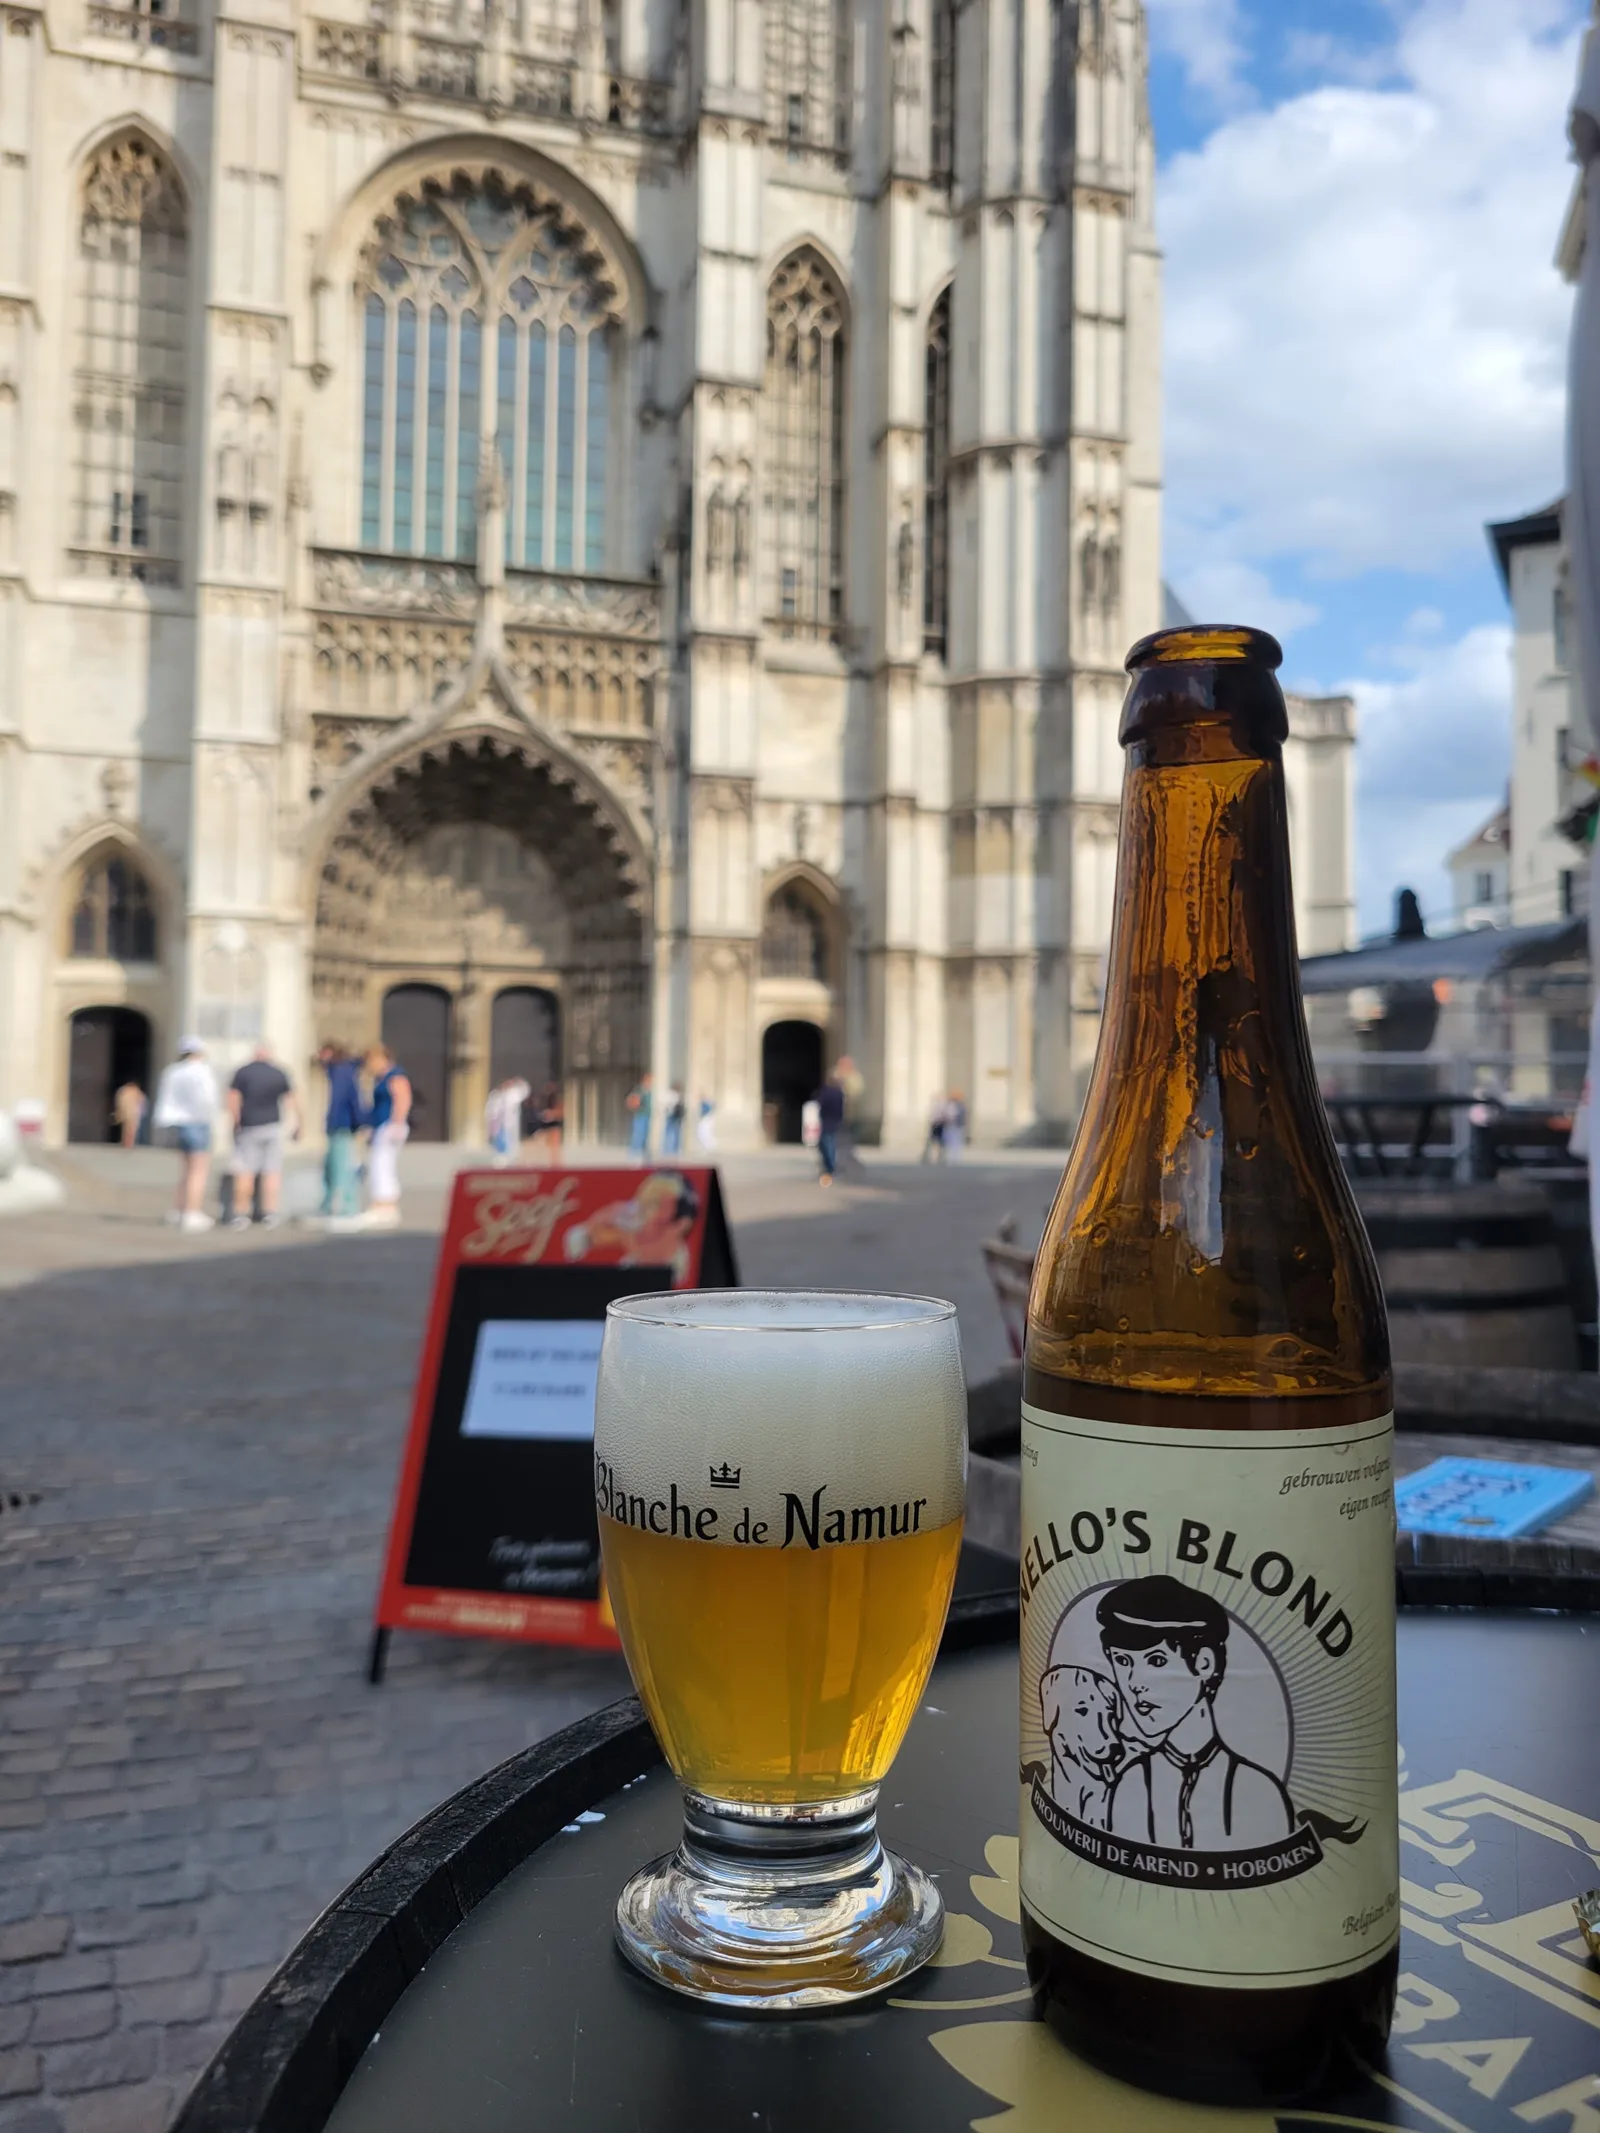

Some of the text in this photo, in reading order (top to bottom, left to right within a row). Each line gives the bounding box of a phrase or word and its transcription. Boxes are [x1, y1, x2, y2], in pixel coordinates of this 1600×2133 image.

[595, 1450, 927, 1551] Blanche de Namur
[1279, 1465, 1361, 1495] gebrouwen
[1339, 1496, 1369, 1520] eigen
[1176, 1518, 1354, 1658] BLOND
[1034, 1790, 1316, 1880] BROUWERIJ DE AREND HOBOKEN
